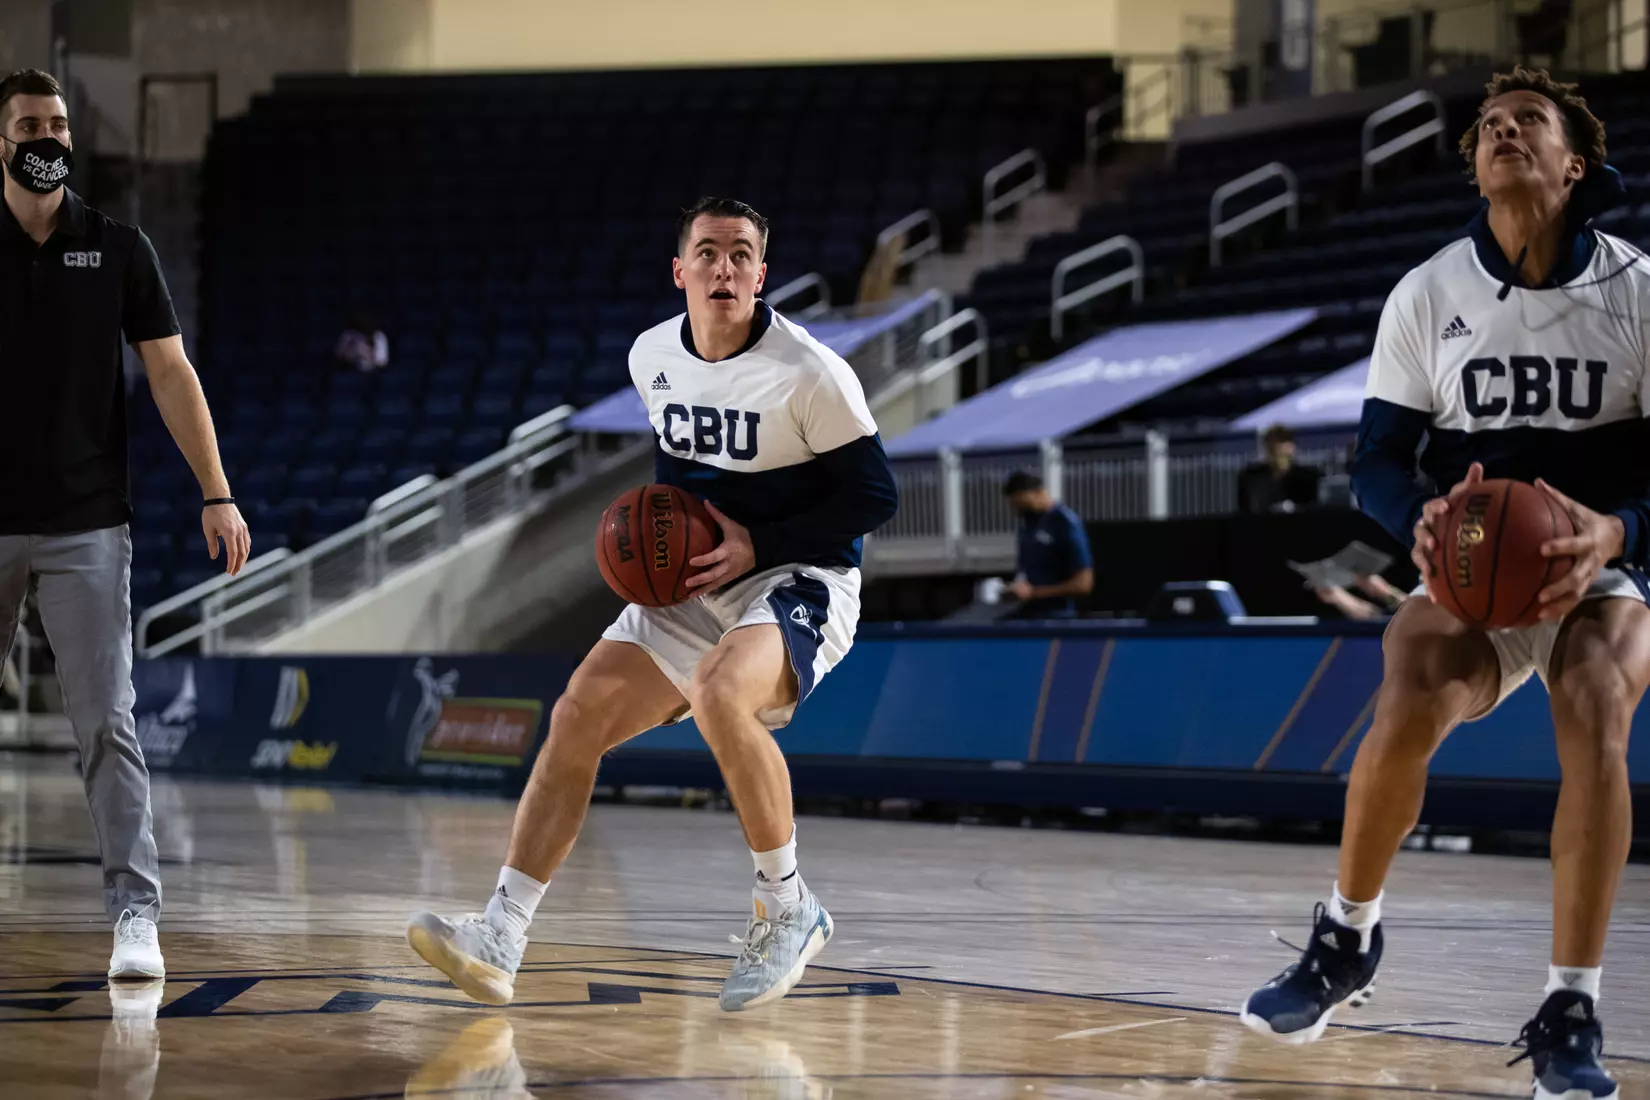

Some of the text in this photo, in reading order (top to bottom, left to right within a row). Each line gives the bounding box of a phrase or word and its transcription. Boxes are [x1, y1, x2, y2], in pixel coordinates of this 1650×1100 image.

[25, 152, 64, 171] COACHES
[22, 163, 69, 181] VS CANCER
[64, 252, 102, 267] CBU
[1441, 328, 1473, 340] adidas
[651, 383, 671, 391] adidas
[1461, 355, 1608, 420] CBU
[663, 402, 761, 461] CBU
[651, 491, 675, 571] Wilson
